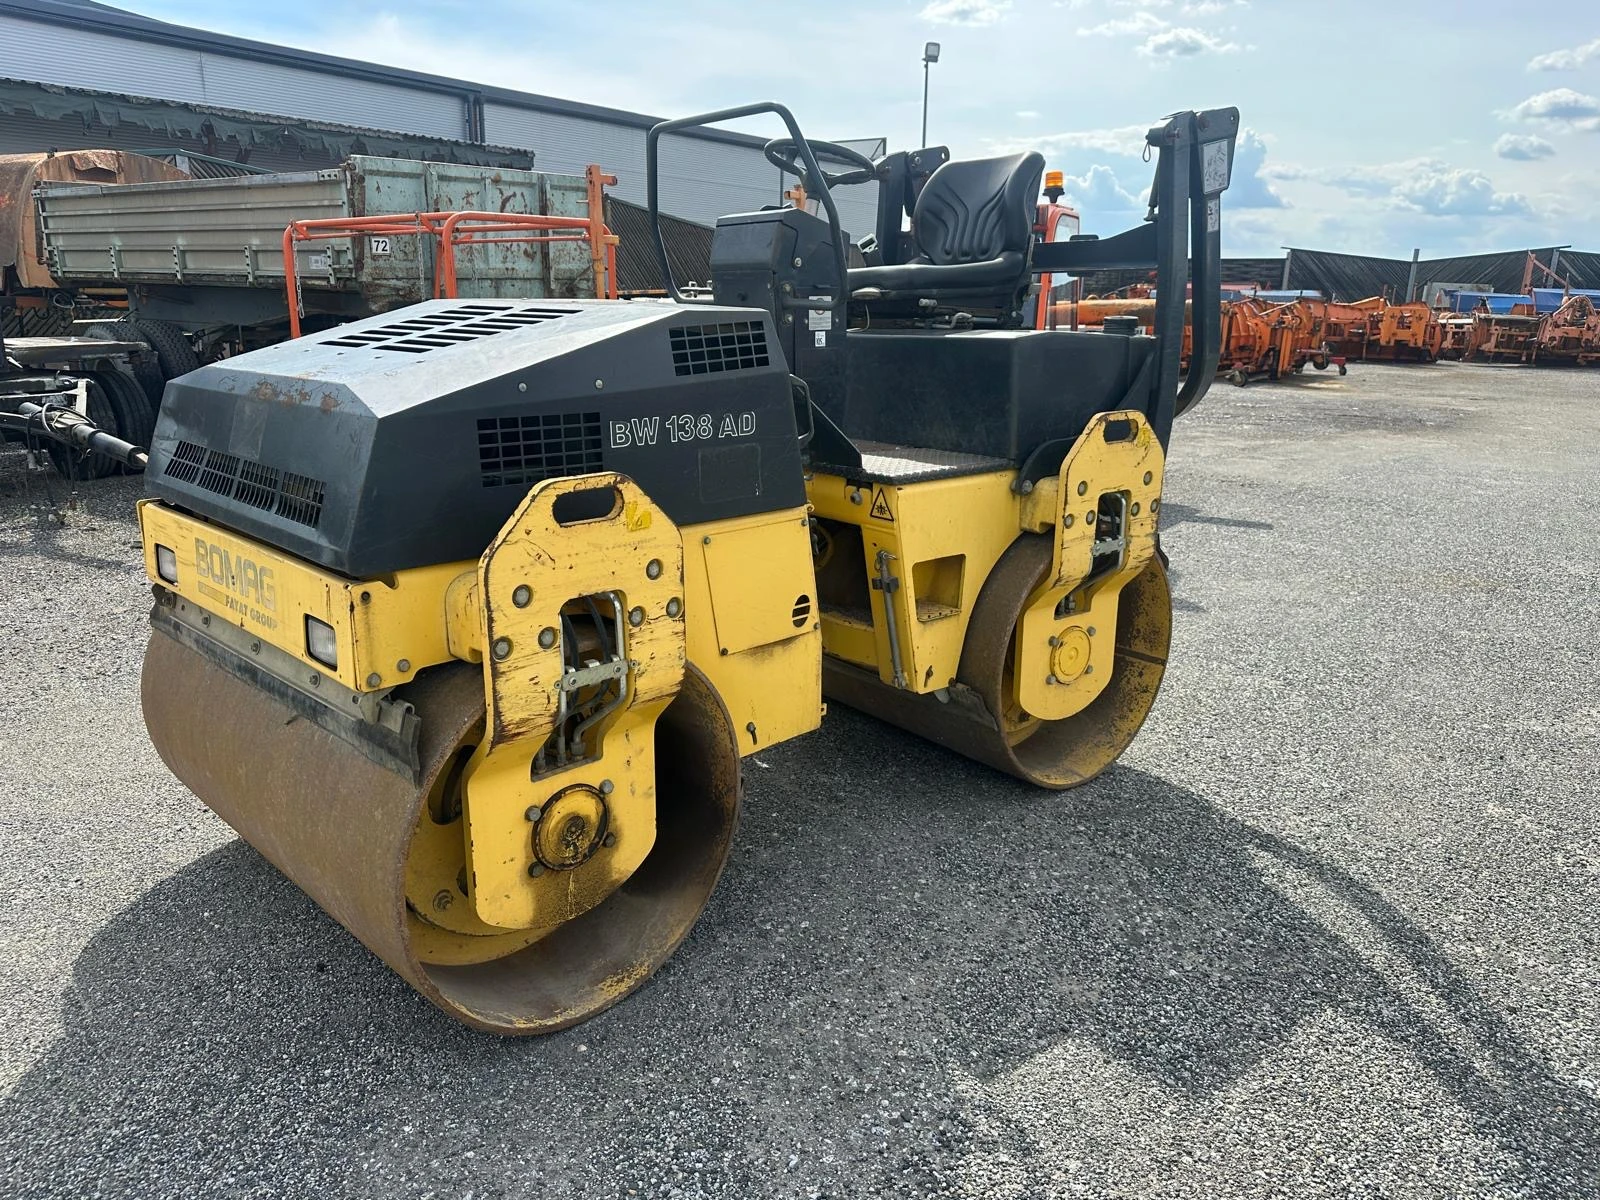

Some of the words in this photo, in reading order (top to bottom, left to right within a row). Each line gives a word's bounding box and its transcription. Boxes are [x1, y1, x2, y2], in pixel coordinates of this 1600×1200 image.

[374, 240, 388, 252] 72
[610, 416, 660, 449] BW
[665, 413, 713, 442] 138
[718, 411, 756, 438] AD
[194, 537, 277, 612] BOMAG
[225, 594, 248, 617] FAYAT
[250, 608, 278, 631] GROUP
